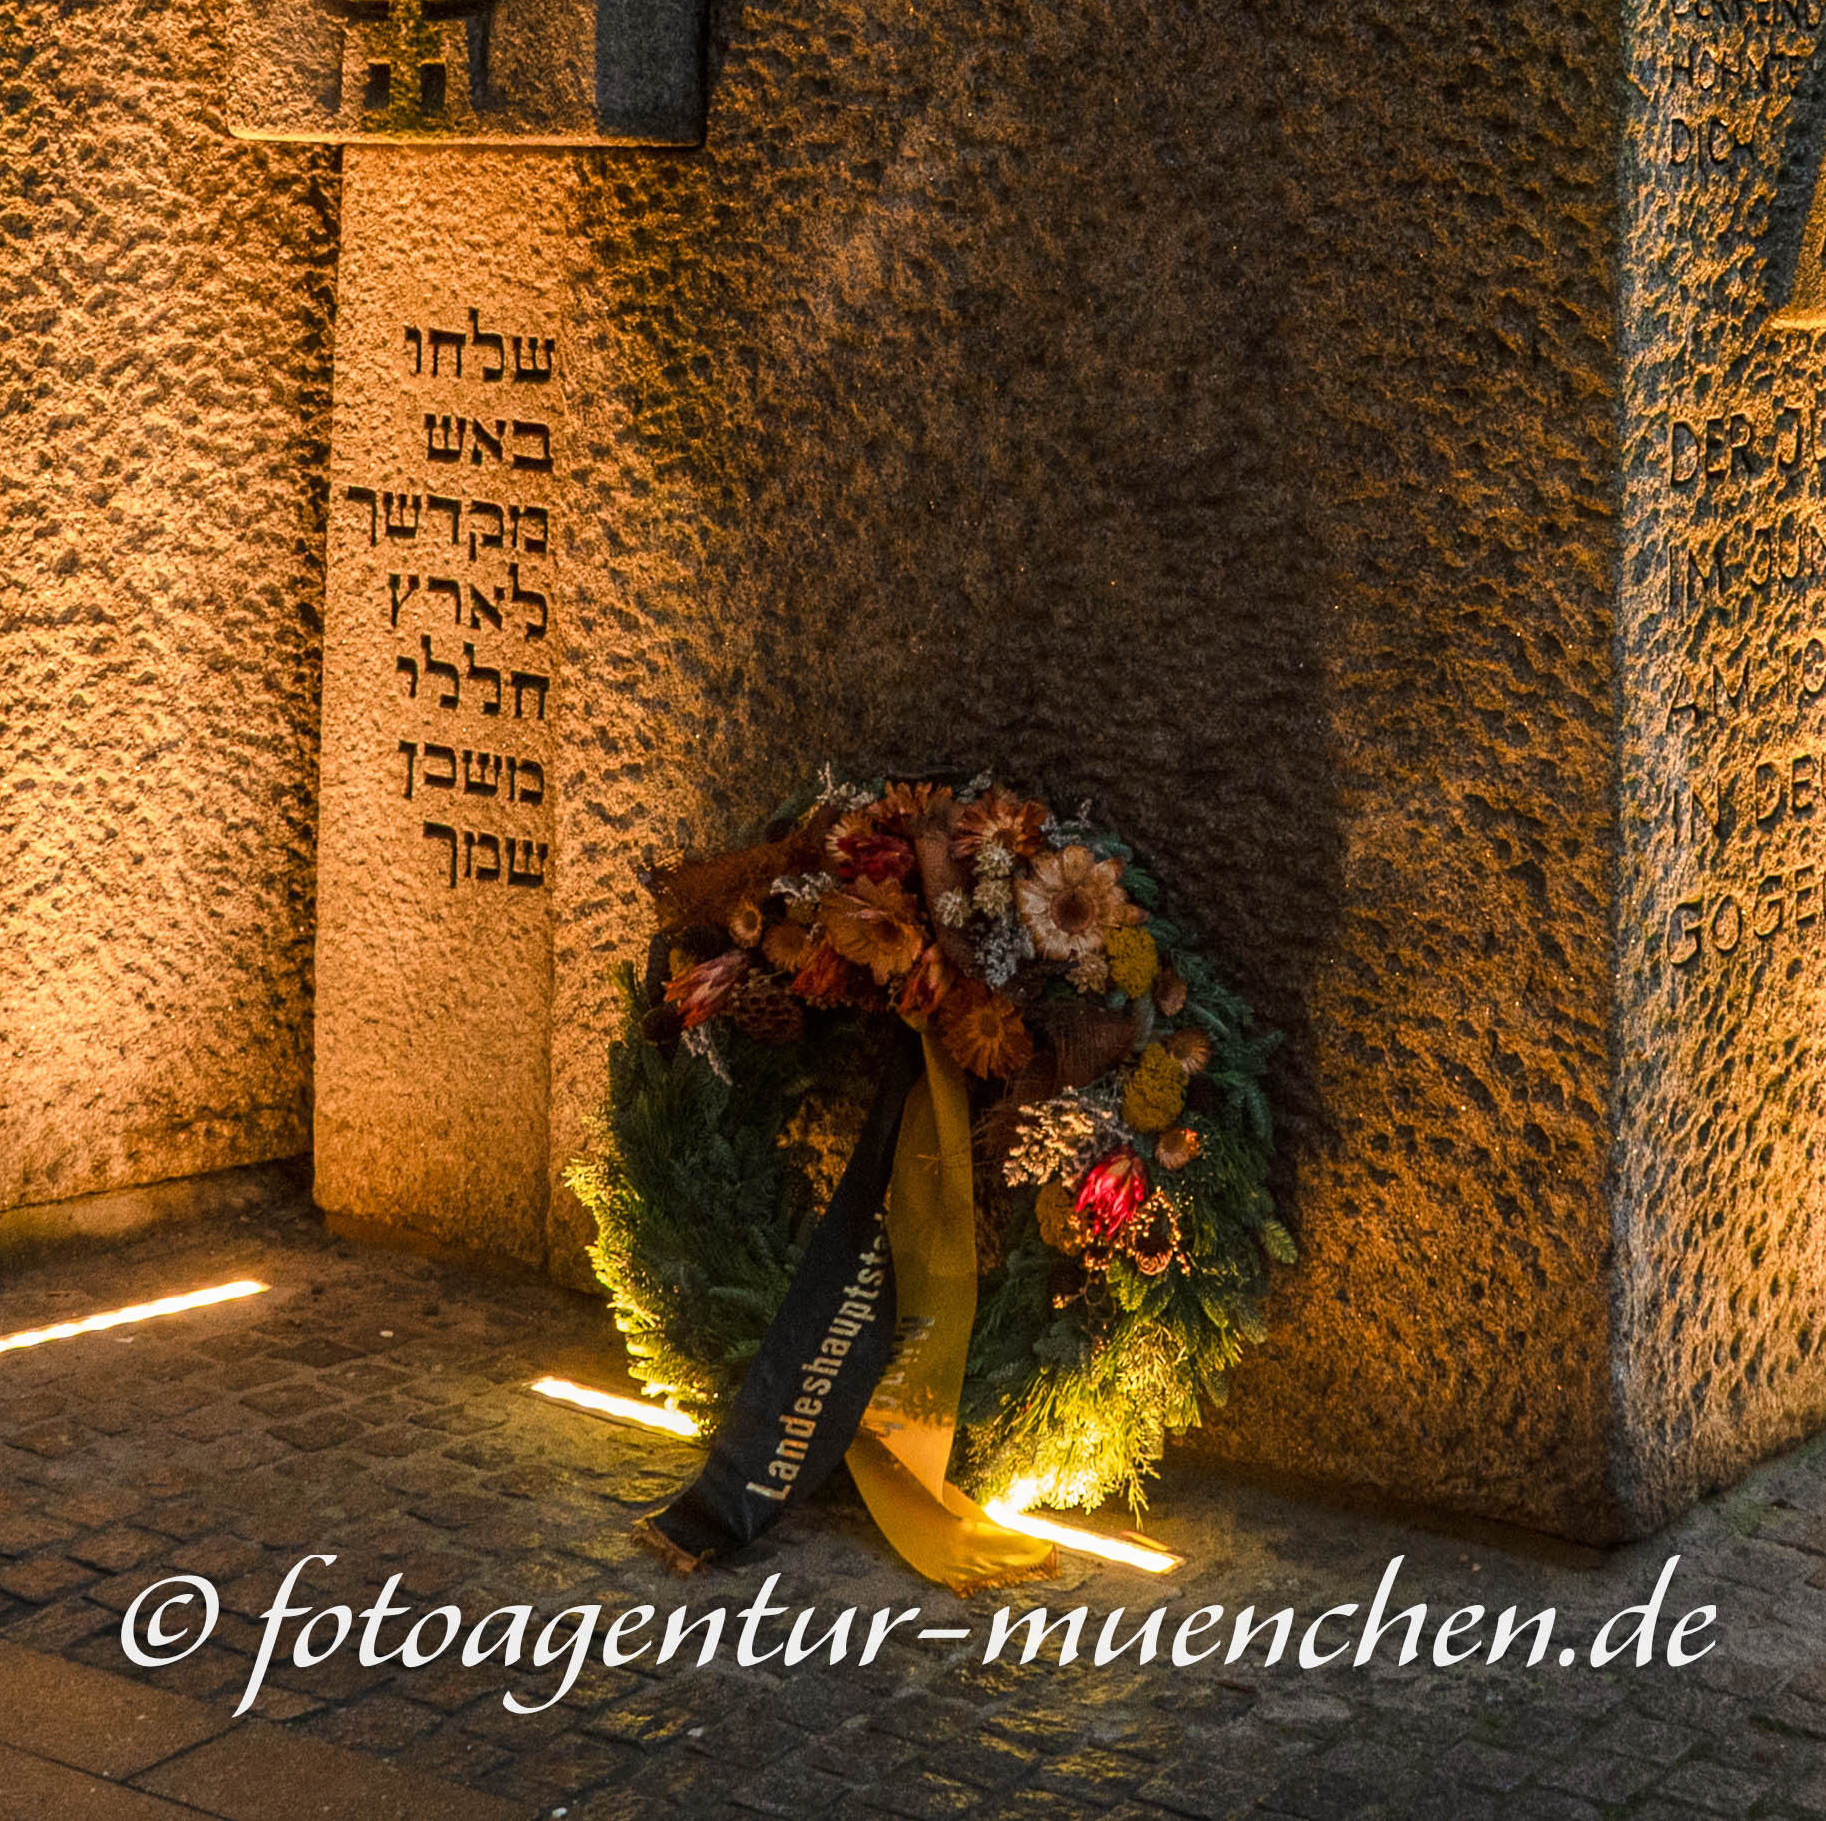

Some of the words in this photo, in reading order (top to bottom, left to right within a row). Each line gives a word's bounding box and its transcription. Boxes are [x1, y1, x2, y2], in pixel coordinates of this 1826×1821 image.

[404, 307, 555, 382] שלחו
[423, 412, 554, 473] באש
[1670, 411, 1751, 488] DER
[388, 562, 548, 639] לארץ
[1666, 536, 1724, 618] IM
[1664, 656, 1753, 730] AM
